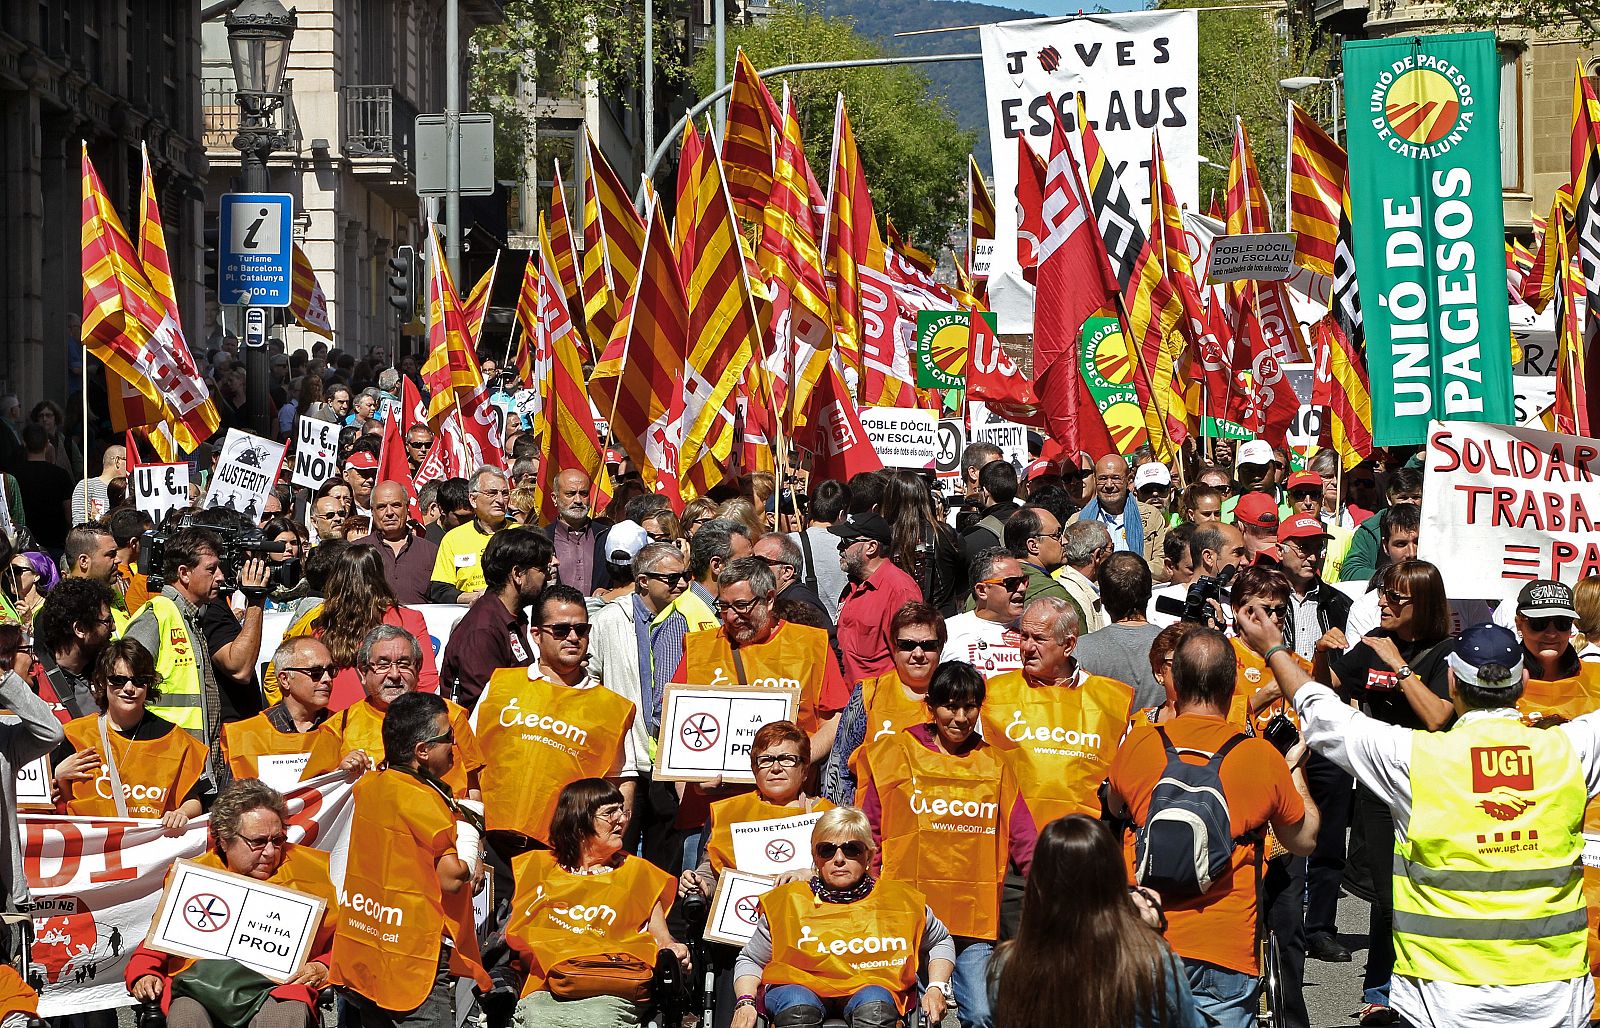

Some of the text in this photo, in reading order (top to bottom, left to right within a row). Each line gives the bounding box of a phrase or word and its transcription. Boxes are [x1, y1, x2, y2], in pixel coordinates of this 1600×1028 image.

[1370, 54, 1474, 113] UNIÓ DE PAGESOS
[1001, 86, 1187, 138] ESCLAUS
[1372, 111, 1474, 160] DE CATALUNYA
[1215, 242, 1294, 255] POBLE DÒCIL,
[227, 264, 283, 272] de Barcelona
[238, 255, 272, 263] Turisme
[1213, 254, 1292, 266] BON ESCLAU,
[225, 273, 284, 282] Pl. Catalunya
[248, 287, 279, 297] 100 m
[1431, 167, 1484, 416] PAGESOS
[1378, 196, 1433, 418] UNIÓ DE
[920, 315, 971, 351] UNIÓ DE PA
[1085, 322, 1119, 360] UNIÓ DE
[920, 353, 935, 371] DE
[1085, 361, 1098, 379] DE
[1107, 392, 1124, 406] DE
[1124, 391, 1139, 405] PA
[300, 418, 315, 446] U.
[861, 419, 936, 433] POBLE DÒCIL,
[1215, 418, 1253, 437] CATAL
[868, 432, 935, 447] ON ESCLAU,
[976, 426, 1023, 447] AUSTERITY
[875, 446, 893, 455] tallades
[138, 468, 160, 498] U.
[217, 462, 271, 495] AUSTERITY
[749, 714, 763, 723] JA
[524, 713, 588, 746] ecom
[1035, 726, 1101, 750] ecom
[731, 743, 752, 756] PR
[1480, 749, 1533, 778] UGT
[16, 768, 38, 782] OU
[931, 798, 999, 819] ecom
[735, 826, 761, 834] PROU
[931, 822, 996, 835] www.ecom.ca
[1478, 842, 1539, 856] www.ugt.cat
[57, 900, 75, 911] NB
[352, 892, 403, 927] ecom
[266, 911, 281, 921] JA
[247, 920, 291, 939] N'HI HA
[348, 917, 400, 943] www.eco.cat
[238, 933, 290, 957] PROU
[829, 936, 907, 956] ecom
